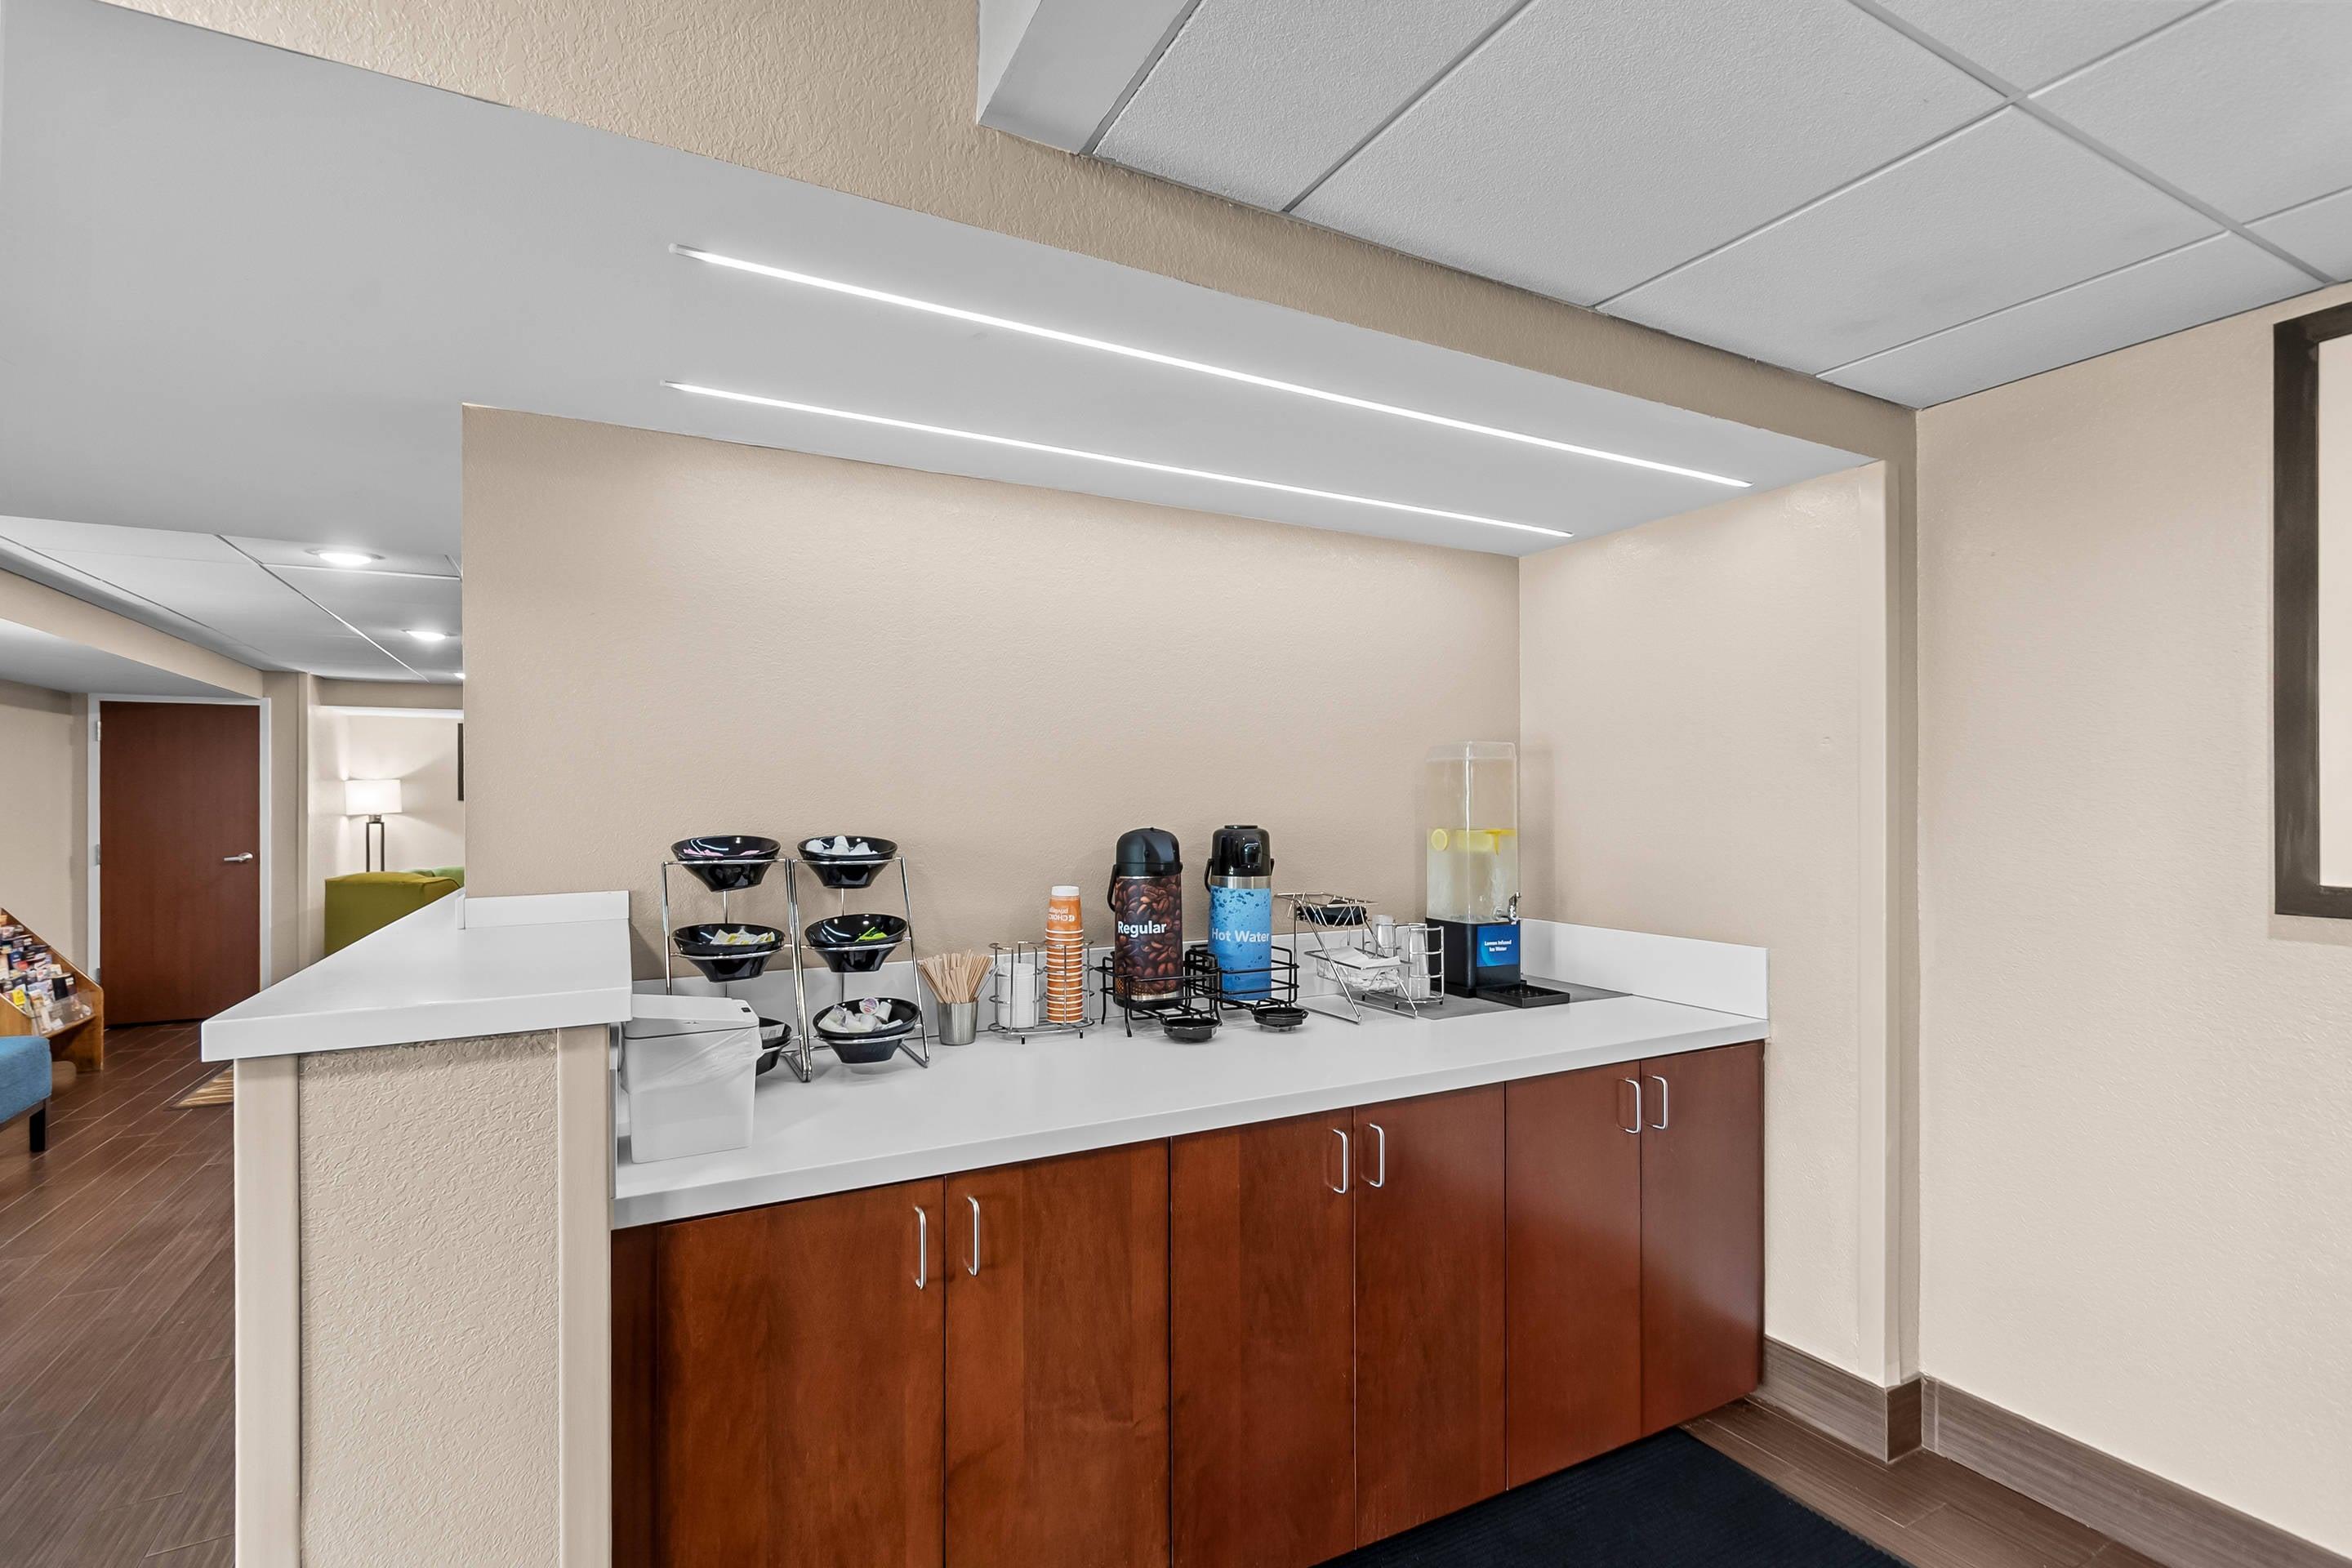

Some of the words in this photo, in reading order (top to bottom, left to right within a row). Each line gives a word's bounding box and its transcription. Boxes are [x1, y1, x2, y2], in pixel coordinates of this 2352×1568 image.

[1048, 914, 1068, 922] CHOIC
[1117, 920, 1167, 938] Regular
[1211, 927, 1231, 942] Hot
[1234, 929, 1270, 942] Water
